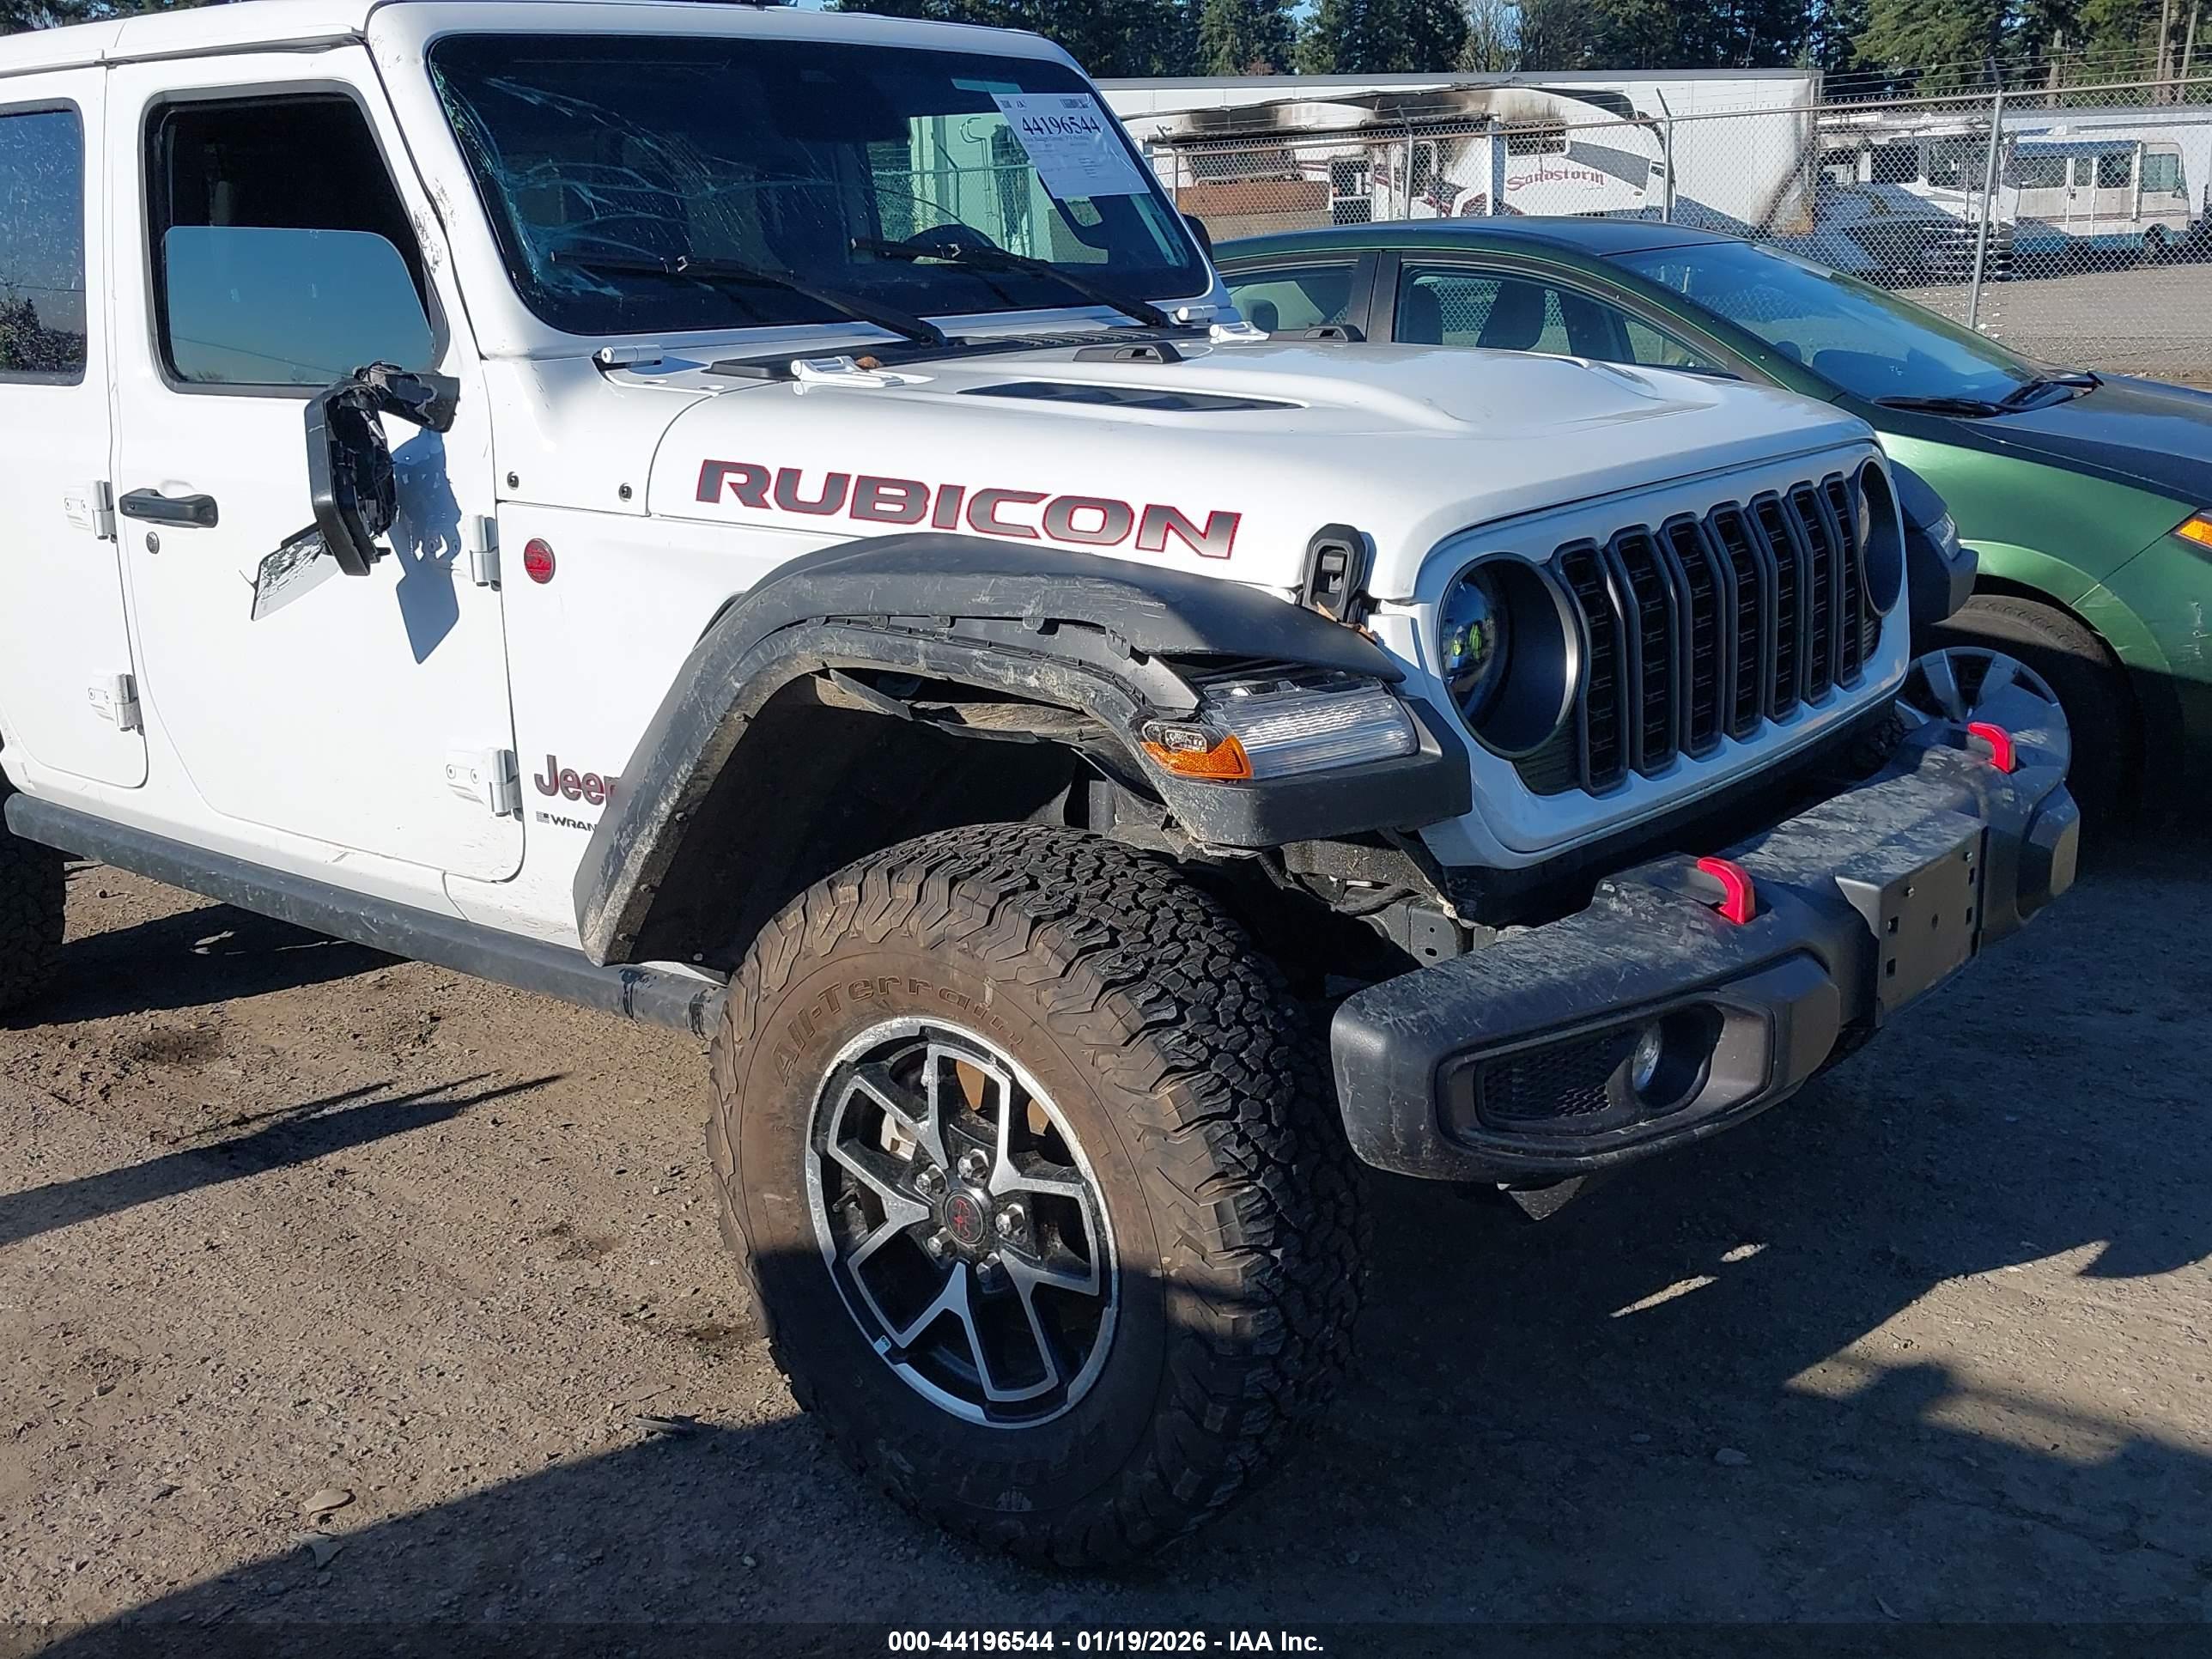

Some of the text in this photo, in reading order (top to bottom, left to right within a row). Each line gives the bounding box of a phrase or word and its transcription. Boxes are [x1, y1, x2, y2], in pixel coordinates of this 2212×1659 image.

[1021, 116, 1103, 135] 44196544
[1506, 169, 1605, 191] Sandstorm
[696, 459, 1243, 559] RUBICON
[550, 813, 598, 832] WRAN
